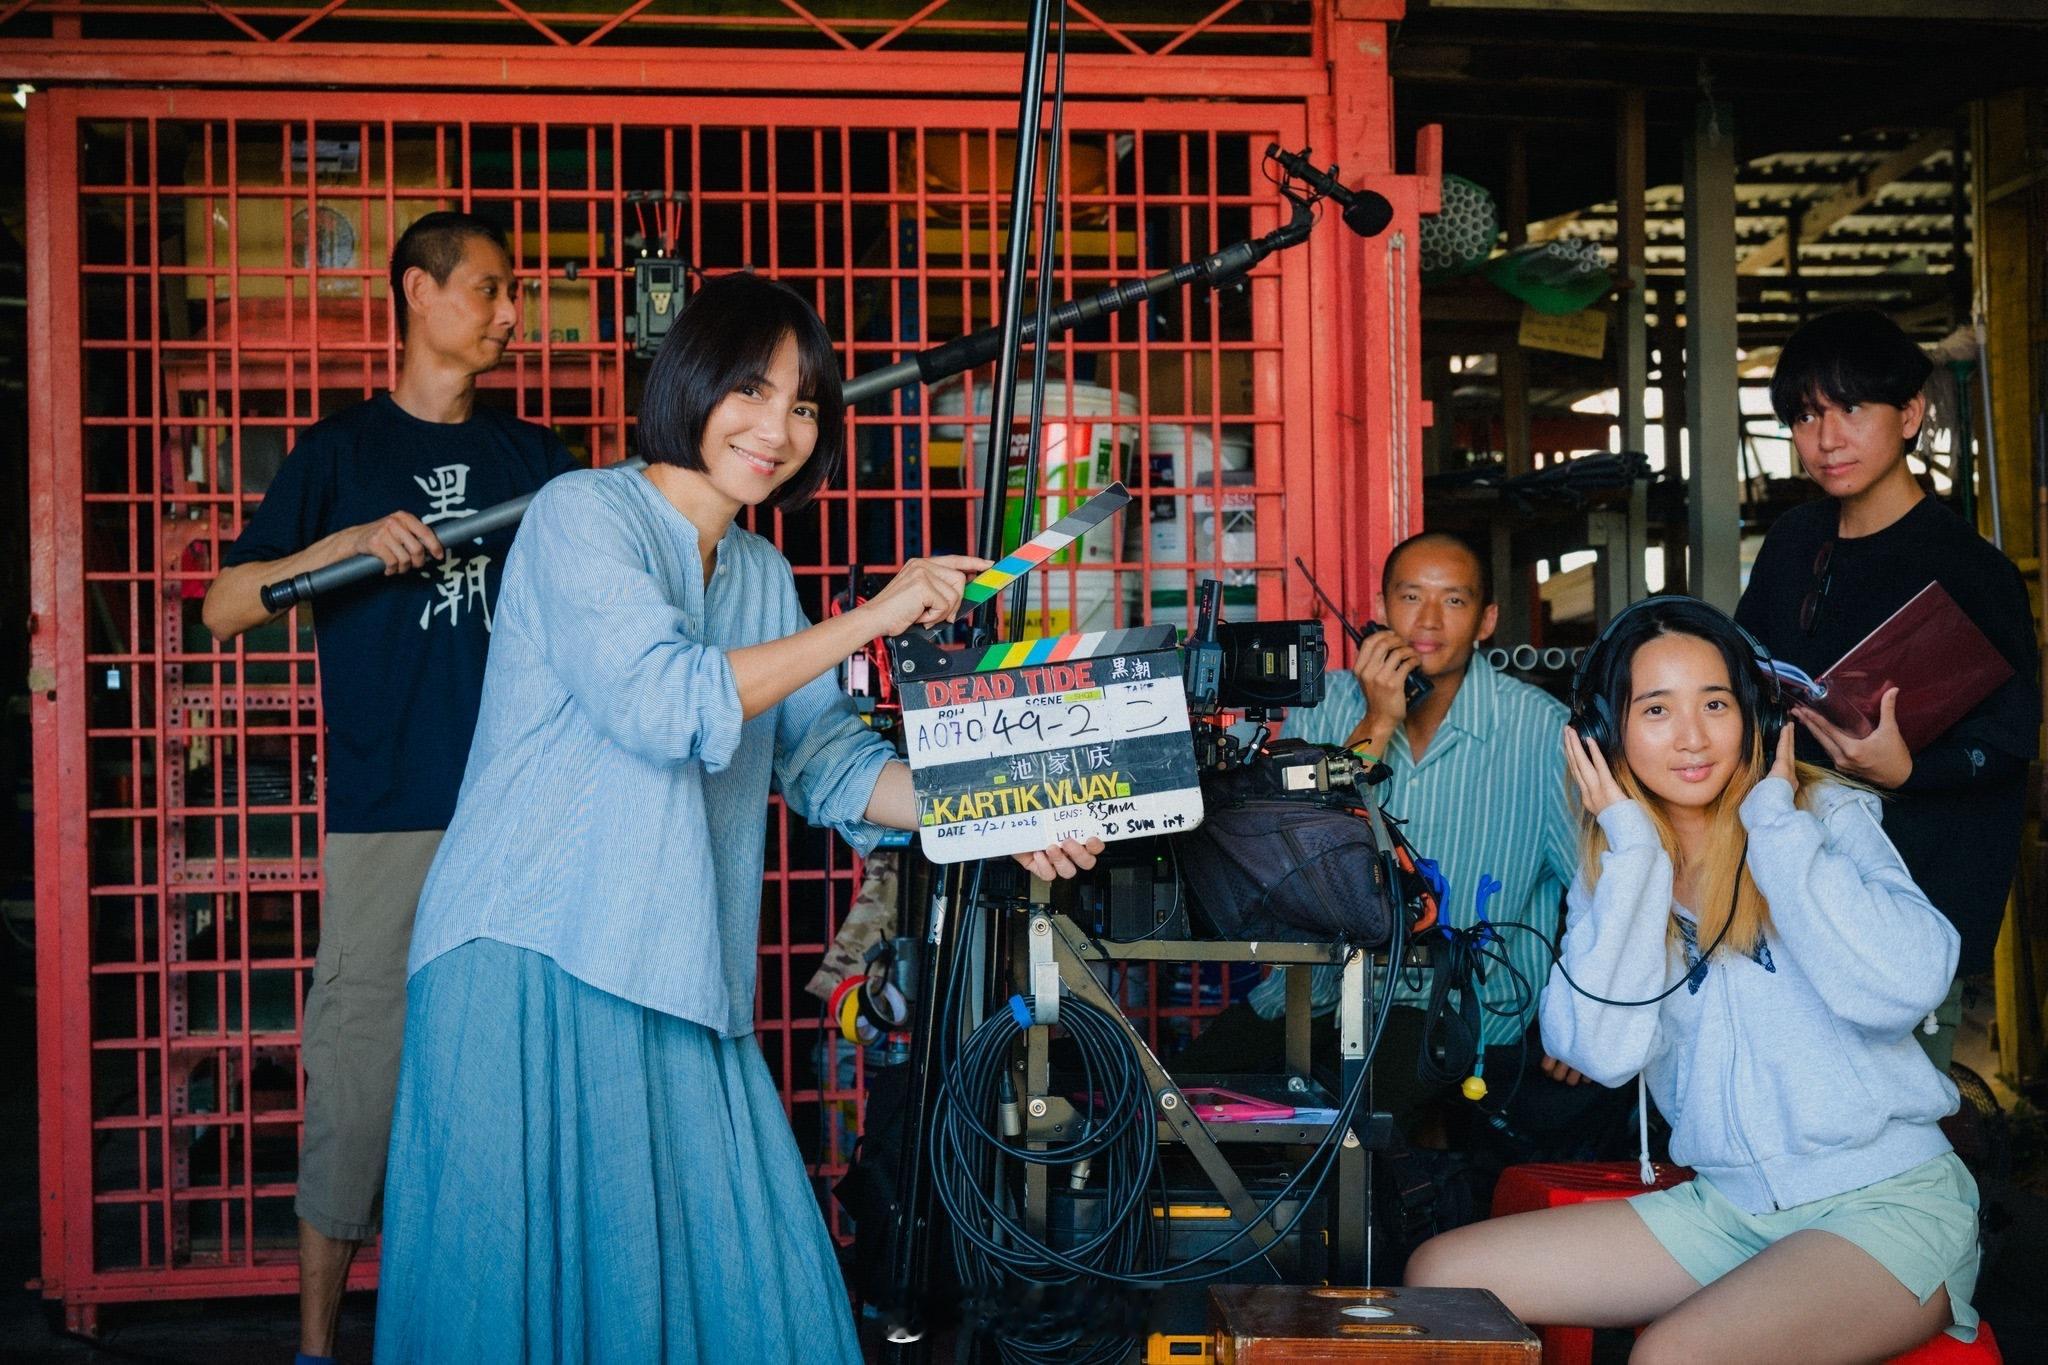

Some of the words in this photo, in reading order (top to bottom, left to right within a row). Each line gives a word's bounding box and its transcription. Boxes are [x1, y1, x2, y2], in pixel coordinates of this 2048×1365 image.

[925, 672, 1015, 708] DEAD
[1020, 661, 1096, 697] TIDE
[1025, 694, 1063, 706] SCENE
[992, 703, 1100, 746] 49-2
[1010, 746, 1113, 781] 池家庆
[932, 784, 1044, 825] KARTIK
[1044, 771, 1119, 807] VIJAY
[1053, 808, 1083, 822] LENS:
[937, 825, 967, 838] DATE
